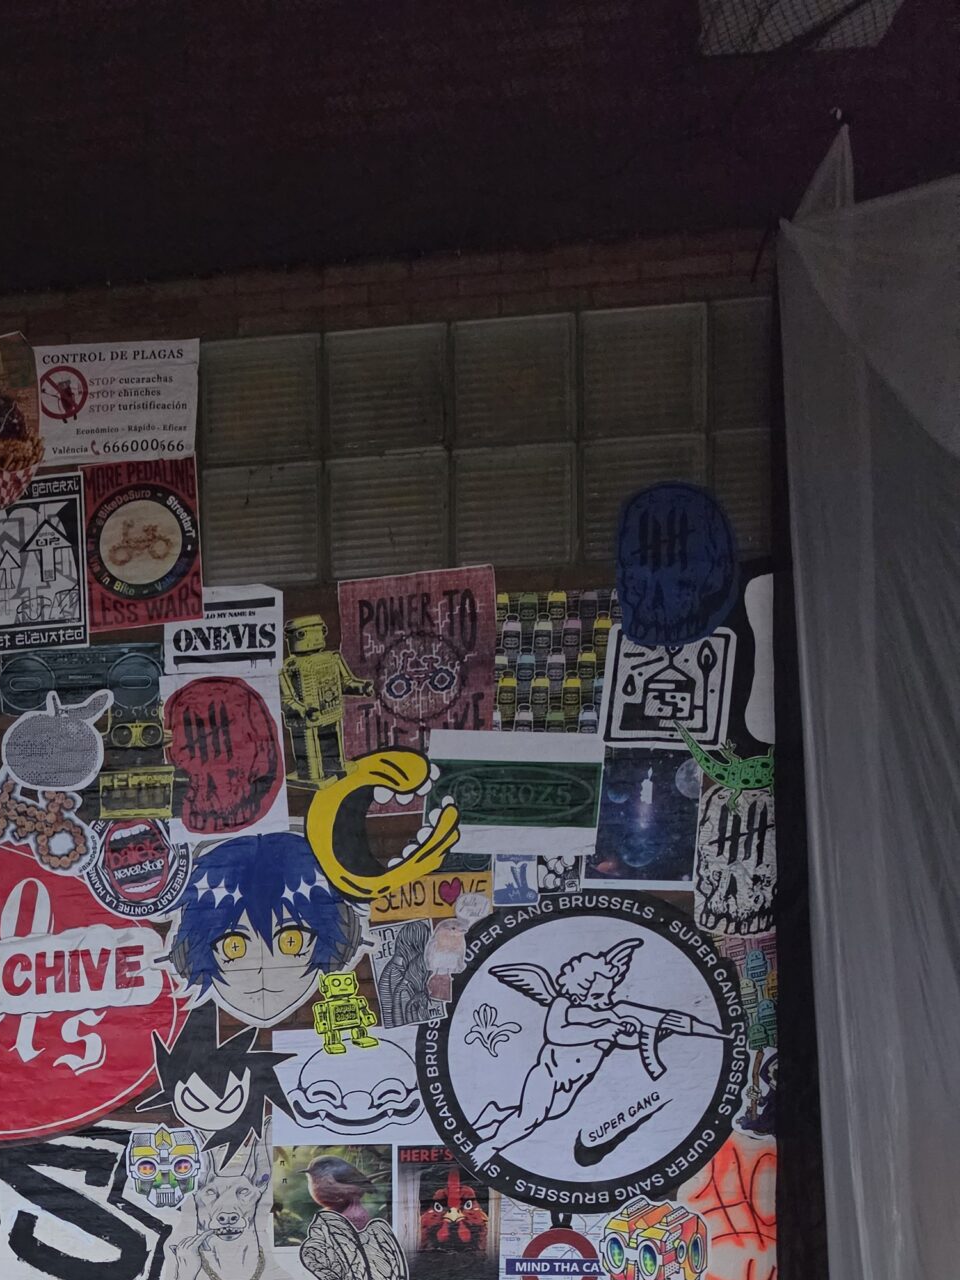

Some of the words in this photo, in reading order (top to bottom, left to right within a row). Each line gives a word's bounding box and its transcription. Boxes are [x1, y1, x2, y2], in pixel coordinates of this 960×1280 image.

[42, 351, 106, 364] CONTROL
[110, 350, 128, 361] DE
[133, 349, 184, 361] PLAGAS
[89, 376, 116, 386] STOP
[119, 374, 173, 385] cucarachas
[89, 390, 116, 399] STOP
[118, 388, 161, 398] chinches
[89, 403, 116, 413] STOP
[118, 401, 188, 411] turistificación
[76, 427, 119, 436] Económico
[128, 424, 156, 433] Rápido
[82, 464, 123, 496] MORE
[126, 457, 196, 498] PEDALING
[90, 591, 139, 628] LESS
[145, 573, 203, 621] WARS
[172, 623, 277, 653] ONEVIS
[358, 592, 437, 665] POWER
[442, 588, 478, 651] TO
[156, 857, 188, 907] STREETART
[118, 904, 155, 915] CONTRE
[464, 926, 504, 964] UPER
[504, 902, 554, 930] SANG
[559, 894, 655, 920] BRUSSELS
[668, 919, 719, 970] SUPER
[713, 966, 744, 1024] GANG
[430, 1080, 459, 1132] GANG
[588, 1118, 628, 1144] SUPER
[626, 1090, 662, 1122] GANG
[400, 1148, 455, 1164] HERE'S
[514, 1177, 611, 1205] BRUSSELS
[614, 1171, 667, 1200] SANG
[515, 1261, 551, 1273] MIND
[554, 1261, 580, 1273] THA
